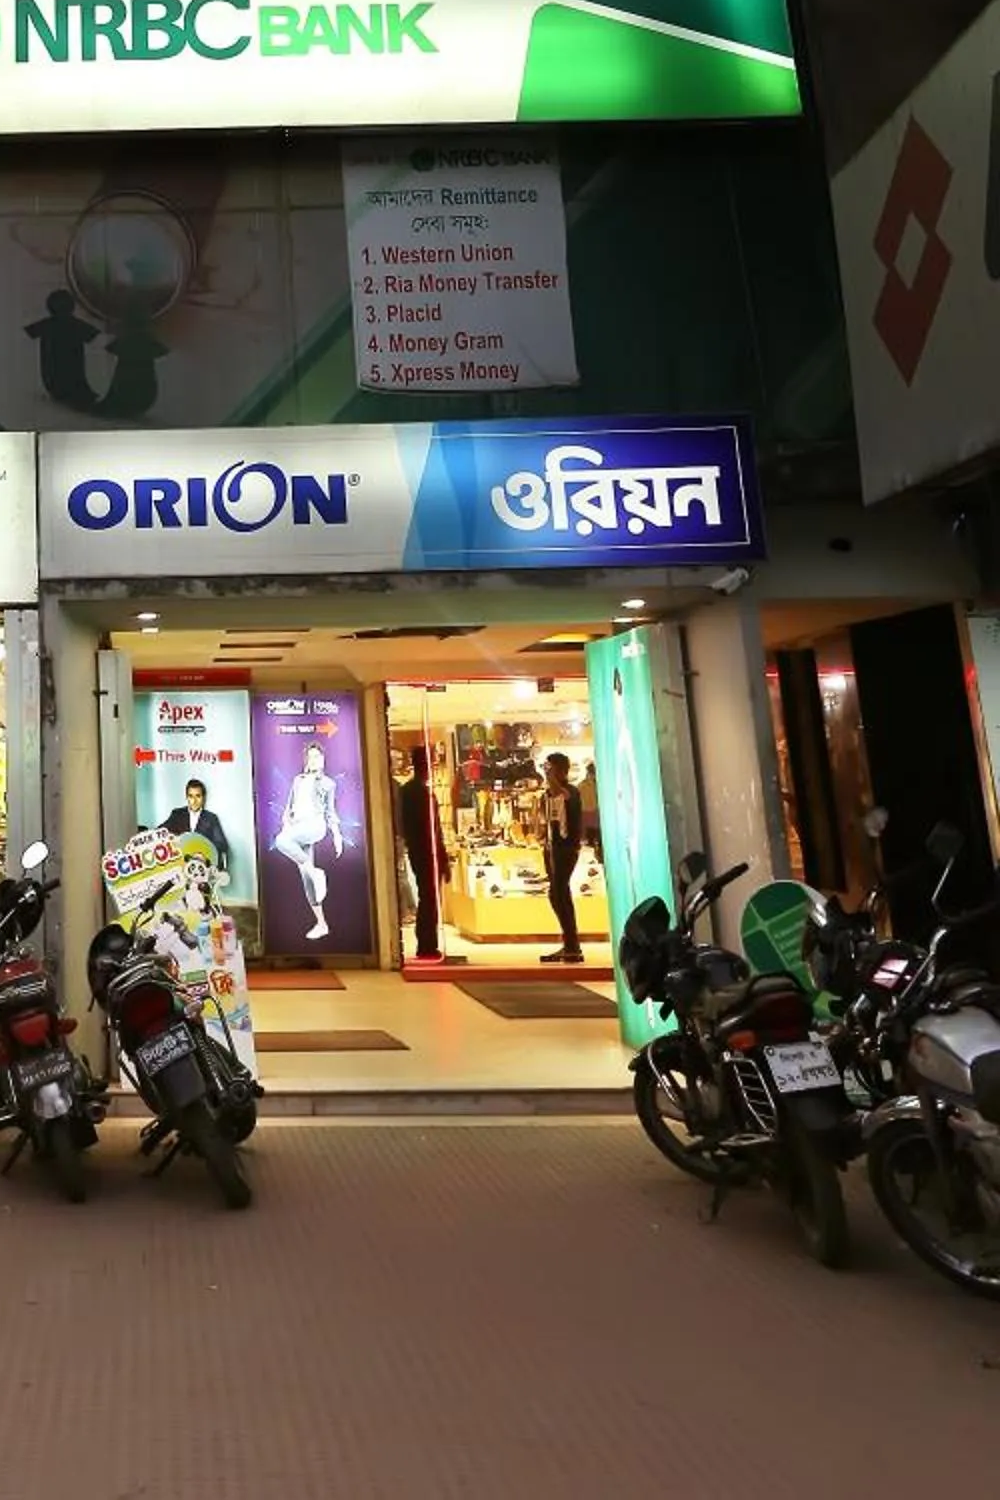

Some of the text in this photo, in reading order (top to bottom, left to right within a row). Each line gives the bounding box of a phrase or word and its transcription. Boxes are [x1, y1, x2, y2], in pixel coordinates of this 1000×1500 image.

[258, 2, 438, 57] BANK
[440, 186, 539, 206] Remittance
[362, 244, 514, 266] 1. Western Union
[363, 270, 559, 296] 2. Ria Money Transfer
[366, 304, 442, 324] 3. Placid
[367, 331, 504, 356] 4. Money Gram
[370, 361, 520, 387] 5. Xpress Money
[66, 460, 349, 532] ORION
[489, 446, 722, 536] ওরিয়ন
[159, 700, 204, 725] Apex
[158, 749, 217, 765] This Way
[104, 841, 181, 879] SCHOOL
